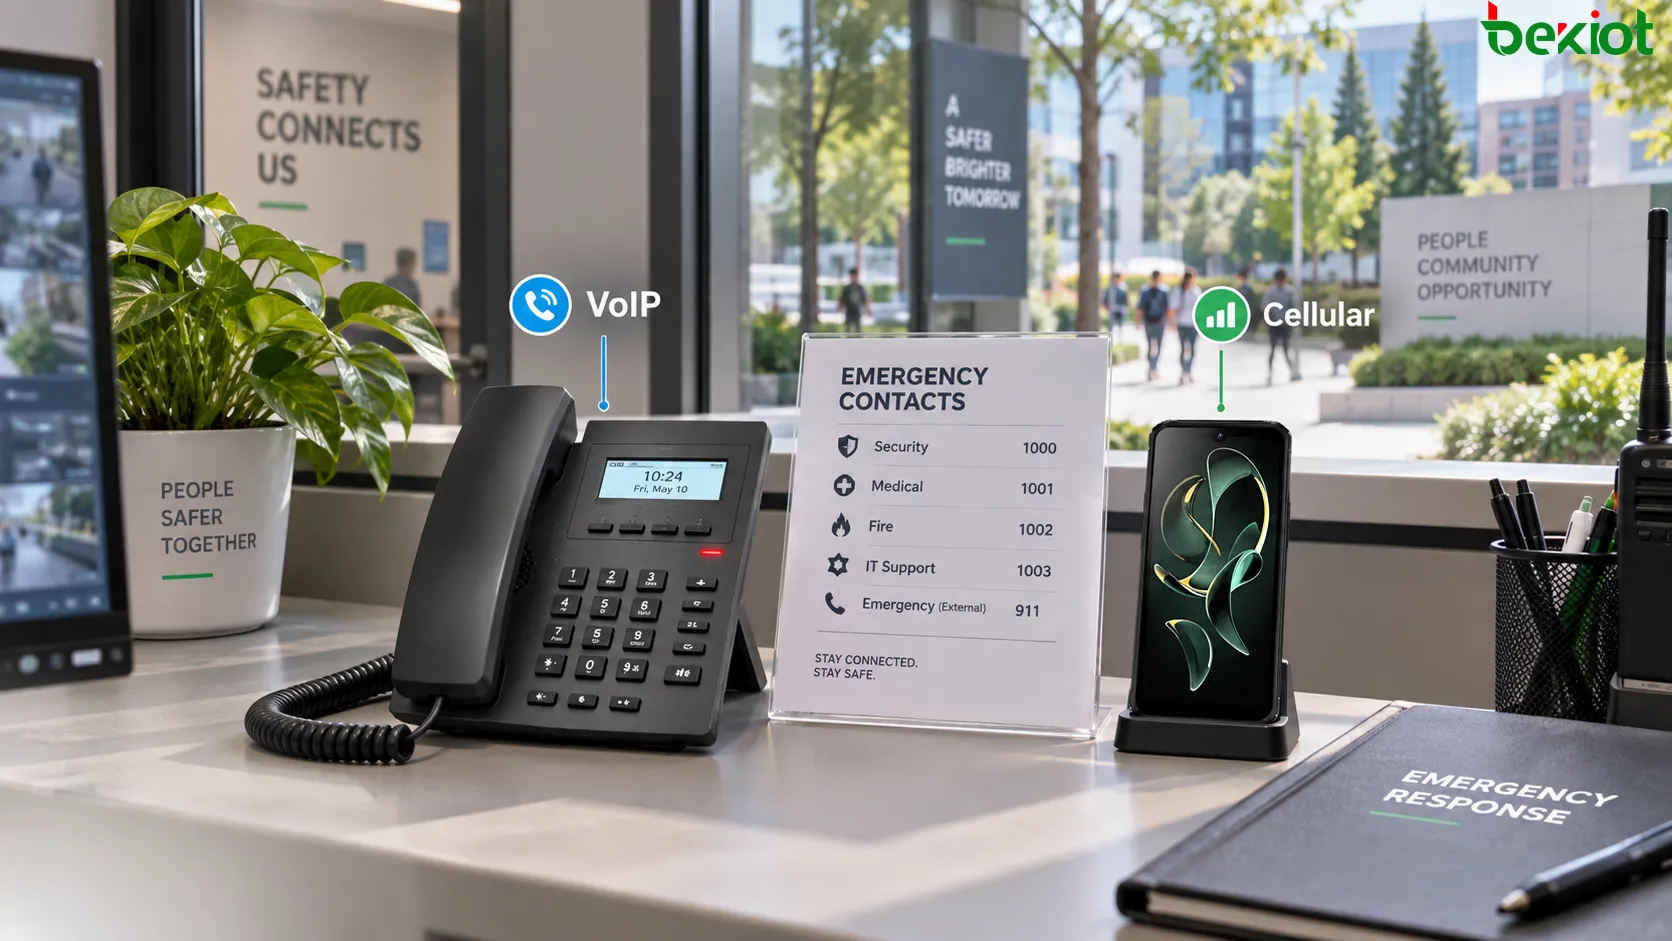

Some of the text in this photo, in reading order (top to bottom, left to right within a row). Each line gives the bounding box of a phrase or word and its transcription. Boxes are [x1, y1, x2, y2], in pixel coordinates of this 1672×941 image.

[257, 68, 370, 106] SAFETY
[945, 94, 960, 118] A
[257, 110, 421, 154] CONNECTS
[945, 125, 992, 153] SAFER
[258, 152, 298, 186] US
[945, 155, 1011, 184] BRIGHTER
[945, 184, 1022, 211] TOMORROW
[1417, 230, 1489, 251] PEOPLE
[1417, 253, 1539, 276] COMMUNITY
[1417, 279, 1552, 301] OPPORTUNITY
[841, 366, 989, 386] EMERGENCY
[839, 391, 966, 412] CONTACTS
[874, 440, 1057, 456] Security 1000
[644, 470, 683, 483] 10:24
[161, 479, 234, 500] PEOPLE
[633, 484, 688, 495] Fri, May 10
[871, 479, 1053, 495] Medical 1001
[161, 508, 223, 527] SAFER
[868, 519, 1053, 536] Fire 1002
[160, 532, 257, 555] TOGETHER
[607, 570, 616, 580] 2
[647, 572, 655, 581] 3
[865, 560, 1052, 578] IT Support 1003
[560, 598, 569, 607] 4
[600, 599, 609, 609] 5
[640, 601, 649, 611] 6
[862, 597, 1040, 618] Emergency (External) 911
[555, 627, 563, 635] 7
[633, 631, 643, 641] 9
[815, 653, 919, 669] STAY CONNECTED.
[813, 667, 877, 682] STAY SAFE.
[1401, 769, 1619, 809] EMERGENCY
[1382, 787, 1573, 826] RESPONSE
